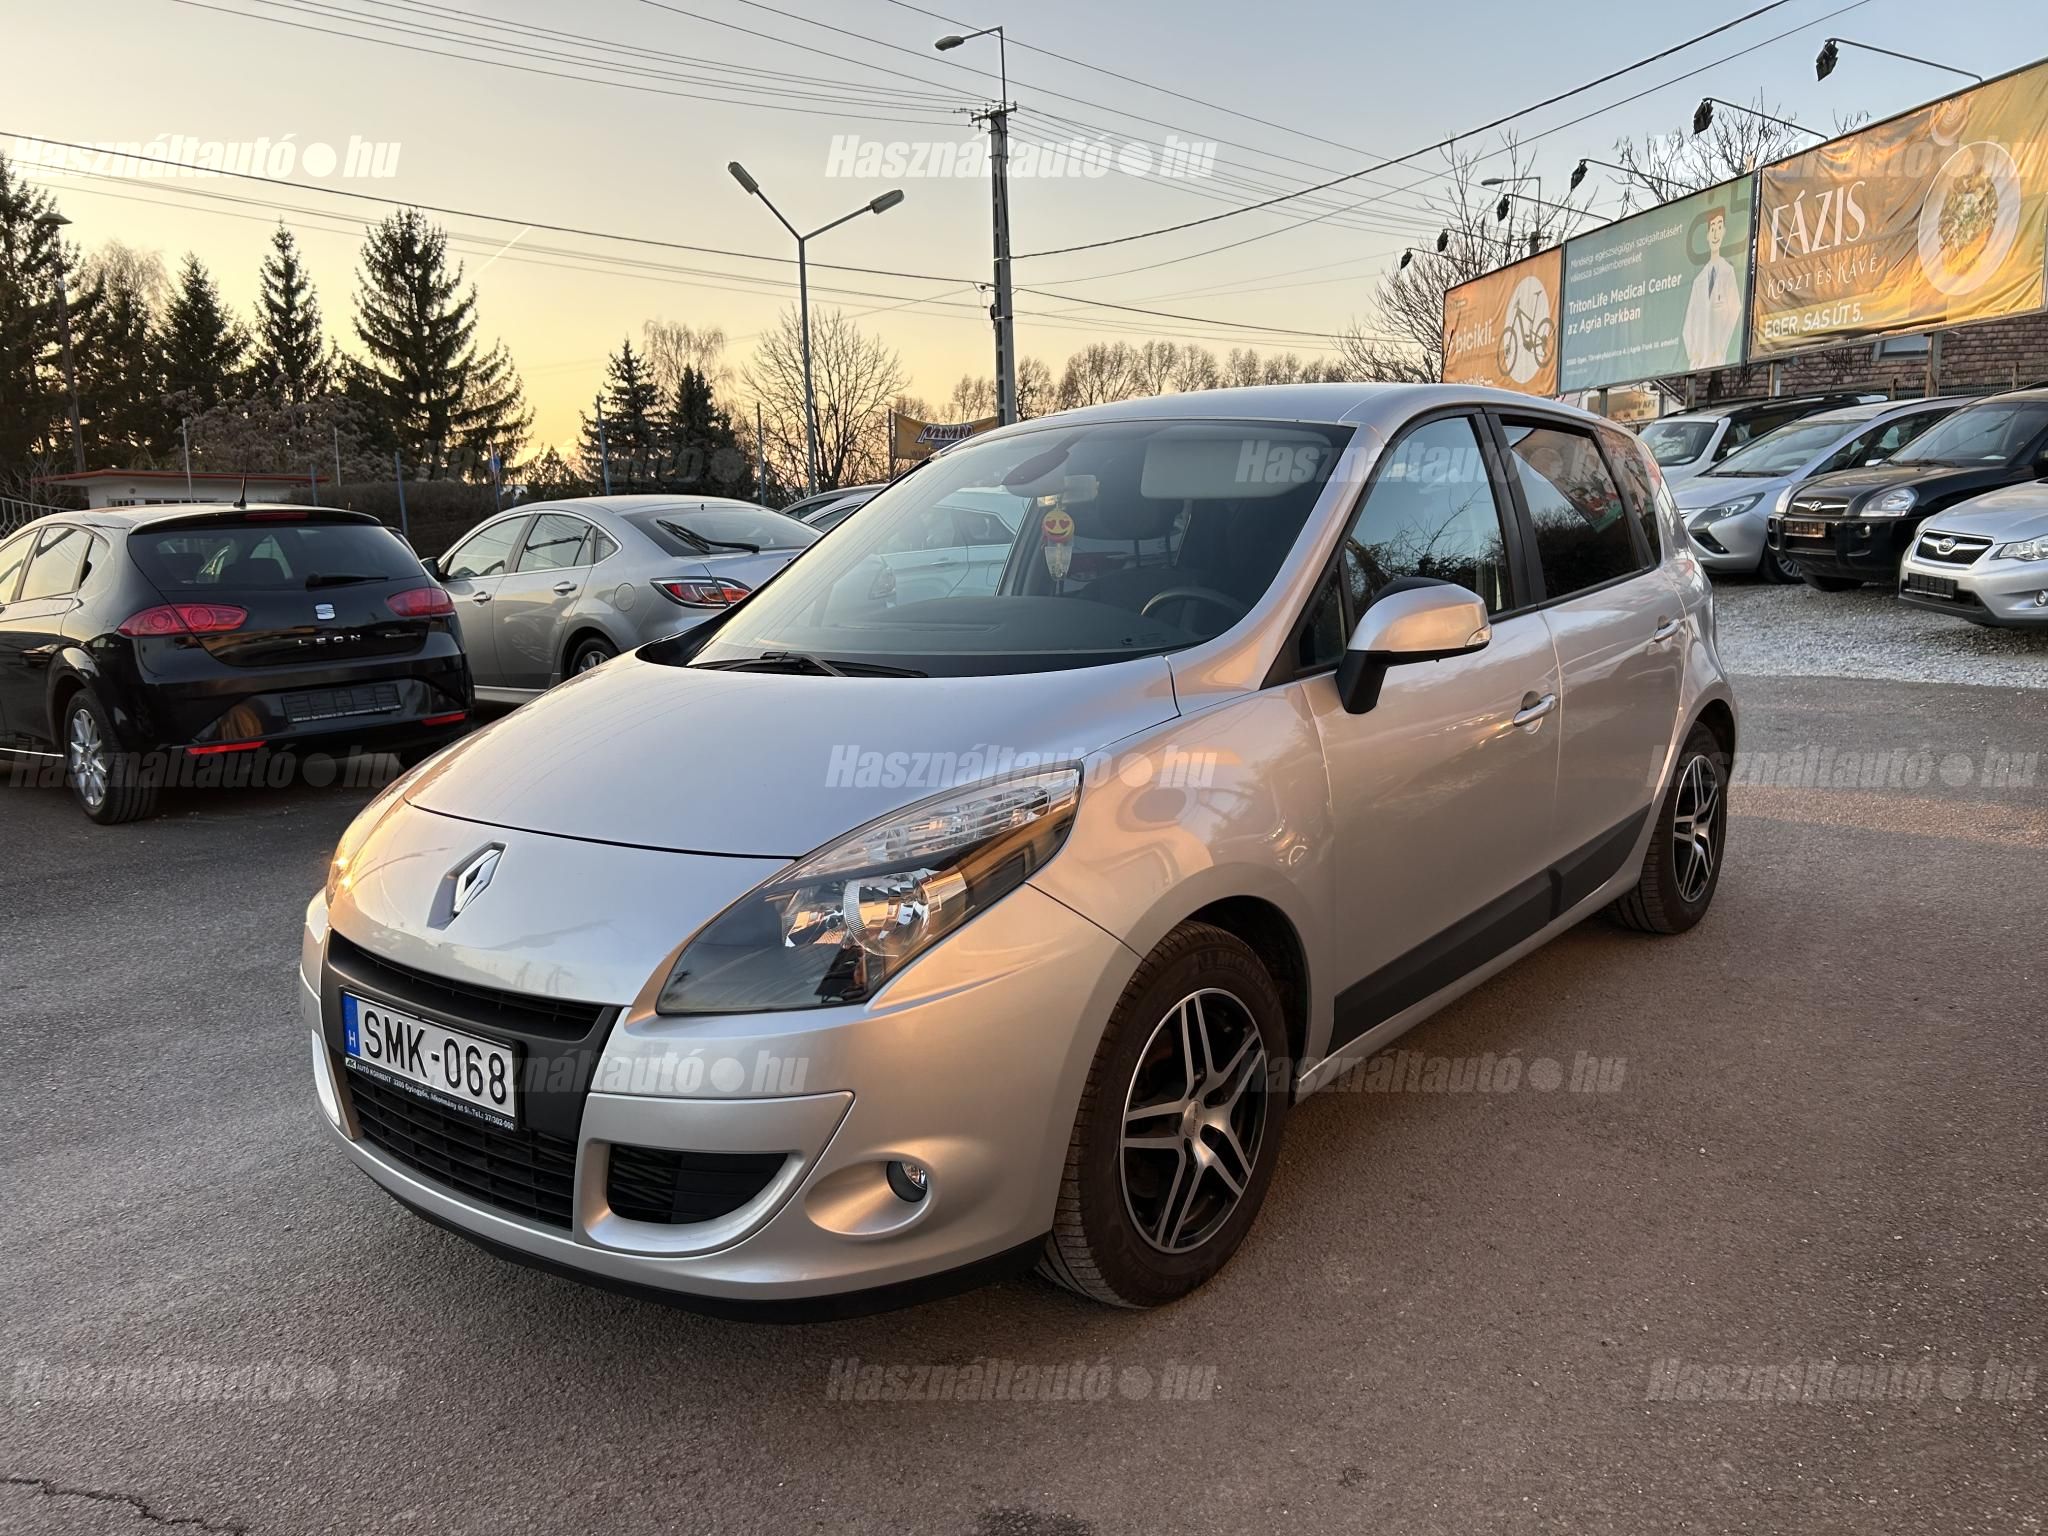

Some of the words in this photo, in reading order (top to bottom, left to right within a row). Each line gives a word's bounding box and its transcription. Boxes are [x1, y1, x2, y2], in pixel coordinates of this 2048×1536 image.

[1770, 181, 1866, 262] FÁZIS
[1768, 273, 1811, 299] KOSZT
[1817, 266, 1832, 285] ÉS
[1838, 253, 1878, 283] KÁVÉ
[1569, 292, 1608, 315] TritonLife
[1611, 281, 1646, 304] Medical
[1649, 274, 1683, 294] Center
[1568, 323, 1578, 336] az
[1579, 316, 1602, 334] Agria
[1604, 307, 1641, 326] Parkban
[1802, 309, 1831, 332] SAS
[1833, 302, 1851, 327] ÚT
[1852, 303, 1864, 322] 5.
[298, 634, 361, 646] LEON
[348, 1029, 356, 1048] H
[365, 1009, 507, 1105] SMK-068
